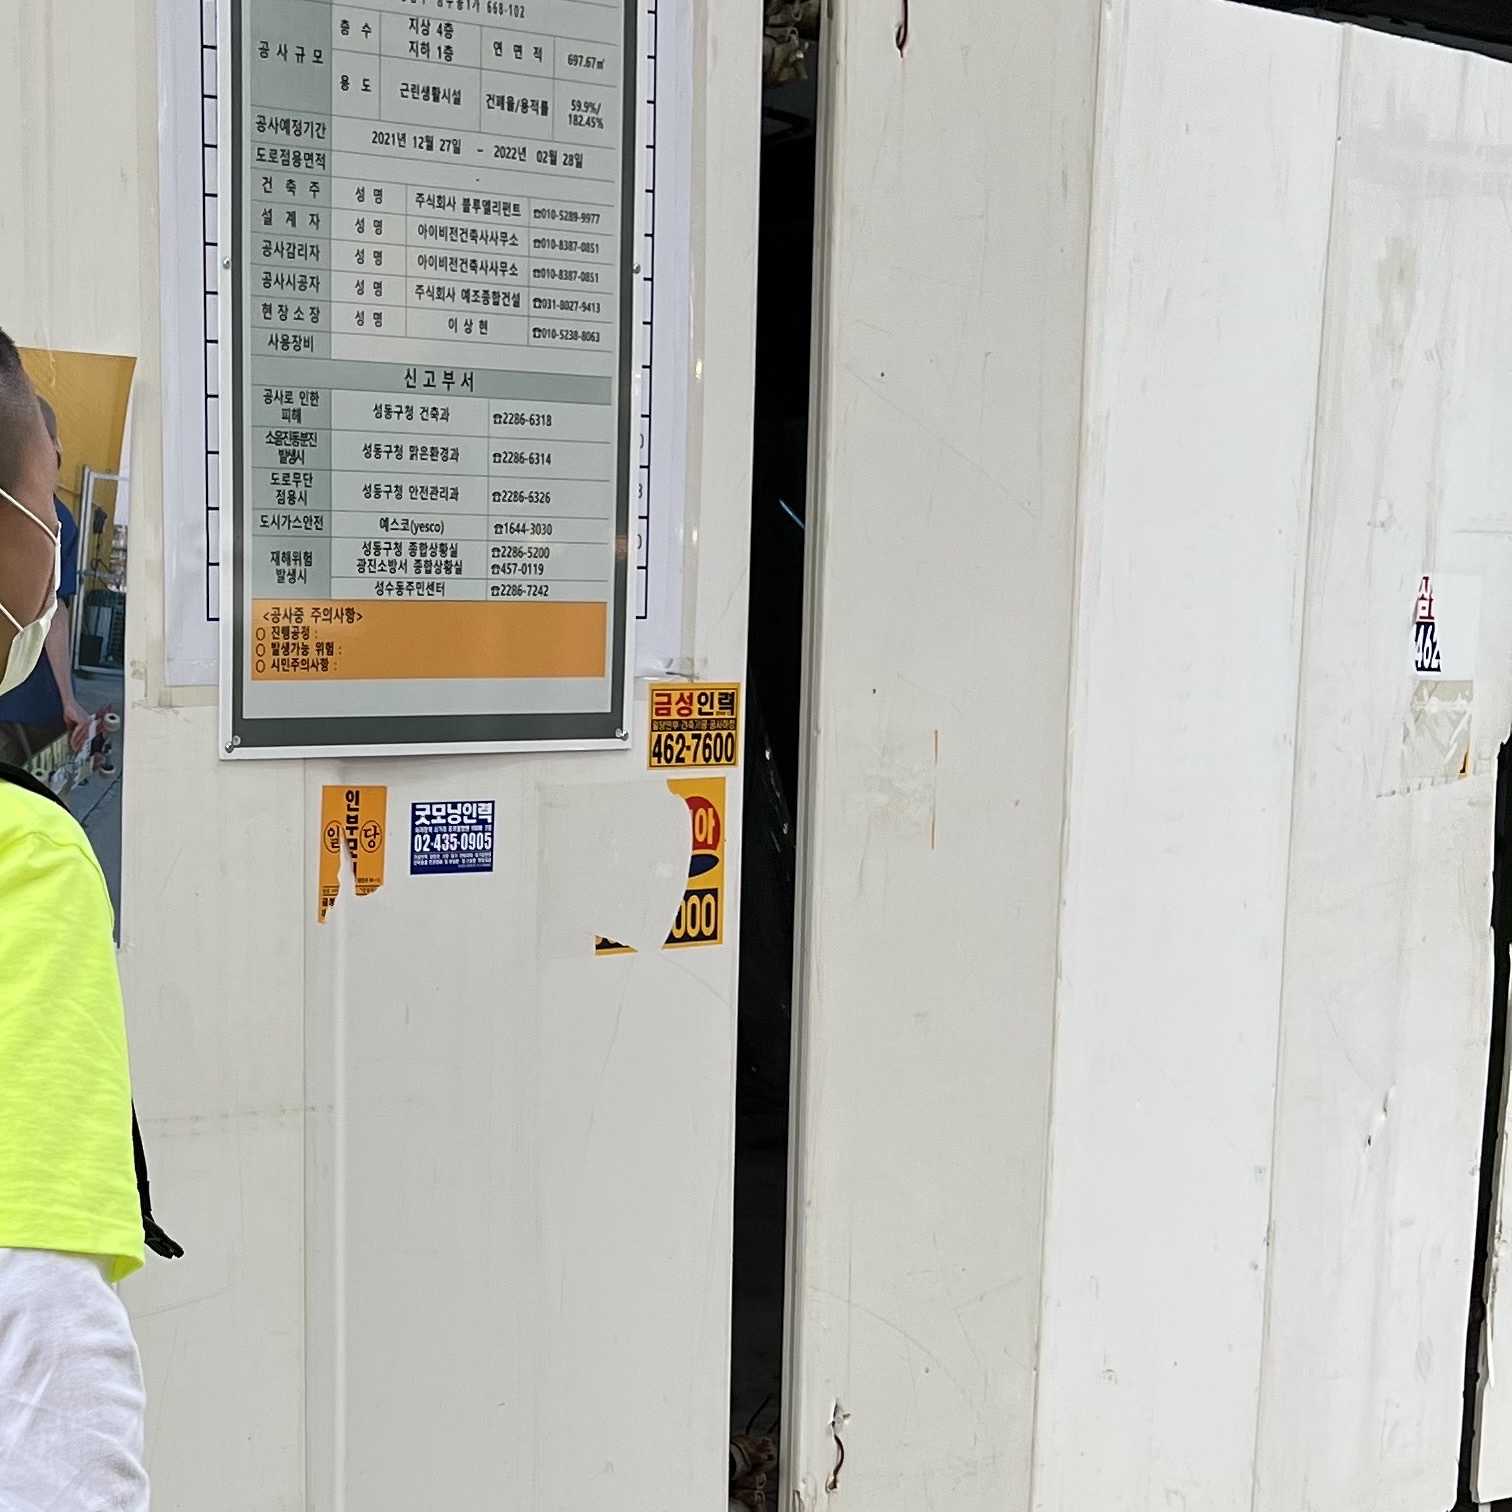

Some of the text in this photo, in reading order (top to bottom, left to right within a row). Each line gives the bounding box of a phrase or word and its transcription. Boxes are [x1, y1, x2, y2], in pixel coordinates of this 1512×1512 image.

[409, 18, 454, 39] 지상 4층
[409, 41, 454, 62] 지하 1층
[400, 83, 462, 106] 근린생활시설
[255, 115, 327, 139] 공사예정기간
[256, 147, 326, 170] 도로점용면적
[372, 131, 583, 169] 2021년 12월 27일 2022년 02월 28일
[415, 192, 456, 211] 주식회사
[417, 223, 519, 247] 아이비전건축사사무소
[261, 240, 320, 262] 공사감리자
[417, 254, 519, 277] 아이비전건축사사무소
[261, 271, 320, 293] 공사시공자
[414, 284, 456, 302] 주식회사
[268, 333, 314, 352] 사용장비
[263, 388, 319, 407] 공사로 인한
[281, 408, 302, 424] 피해
[372, 403, 450, 423] 성동구청 건축과
[278, 449, 305, 465] 발생시
[362, 443, 460, 463] 성동구청 맑은환경과
[270, 472, 313, 488] 도로무단
[275, 490, 307, 506] 점용시
[362, 483, 459, 502] 성동구청 안전관리과
[259, 514, 324, 531] 도시가스안전
[379, 517, 445, 535] 예스코(yesco)
[270, 551, 313, 567] 재해위험
[362, 541, 458, 558] 성동구청 종합상황실
[356, 558, 463, 575] 광진소방서 종합상황실
[276, 568, 307, 585] 발생시
[374, 581, 446, 597] 성수동주민센터
[271, 625, 310, 641] 진행공정
[271, 641, 335, 657] 발생가능 위험
[271, 657, 329, 672] 시민주의사항
[654, 691, 735, 717] 금성인력
[652, 731, 734, 764] 462-7600
[415, 802, 493, 825] 굿모닝인력
